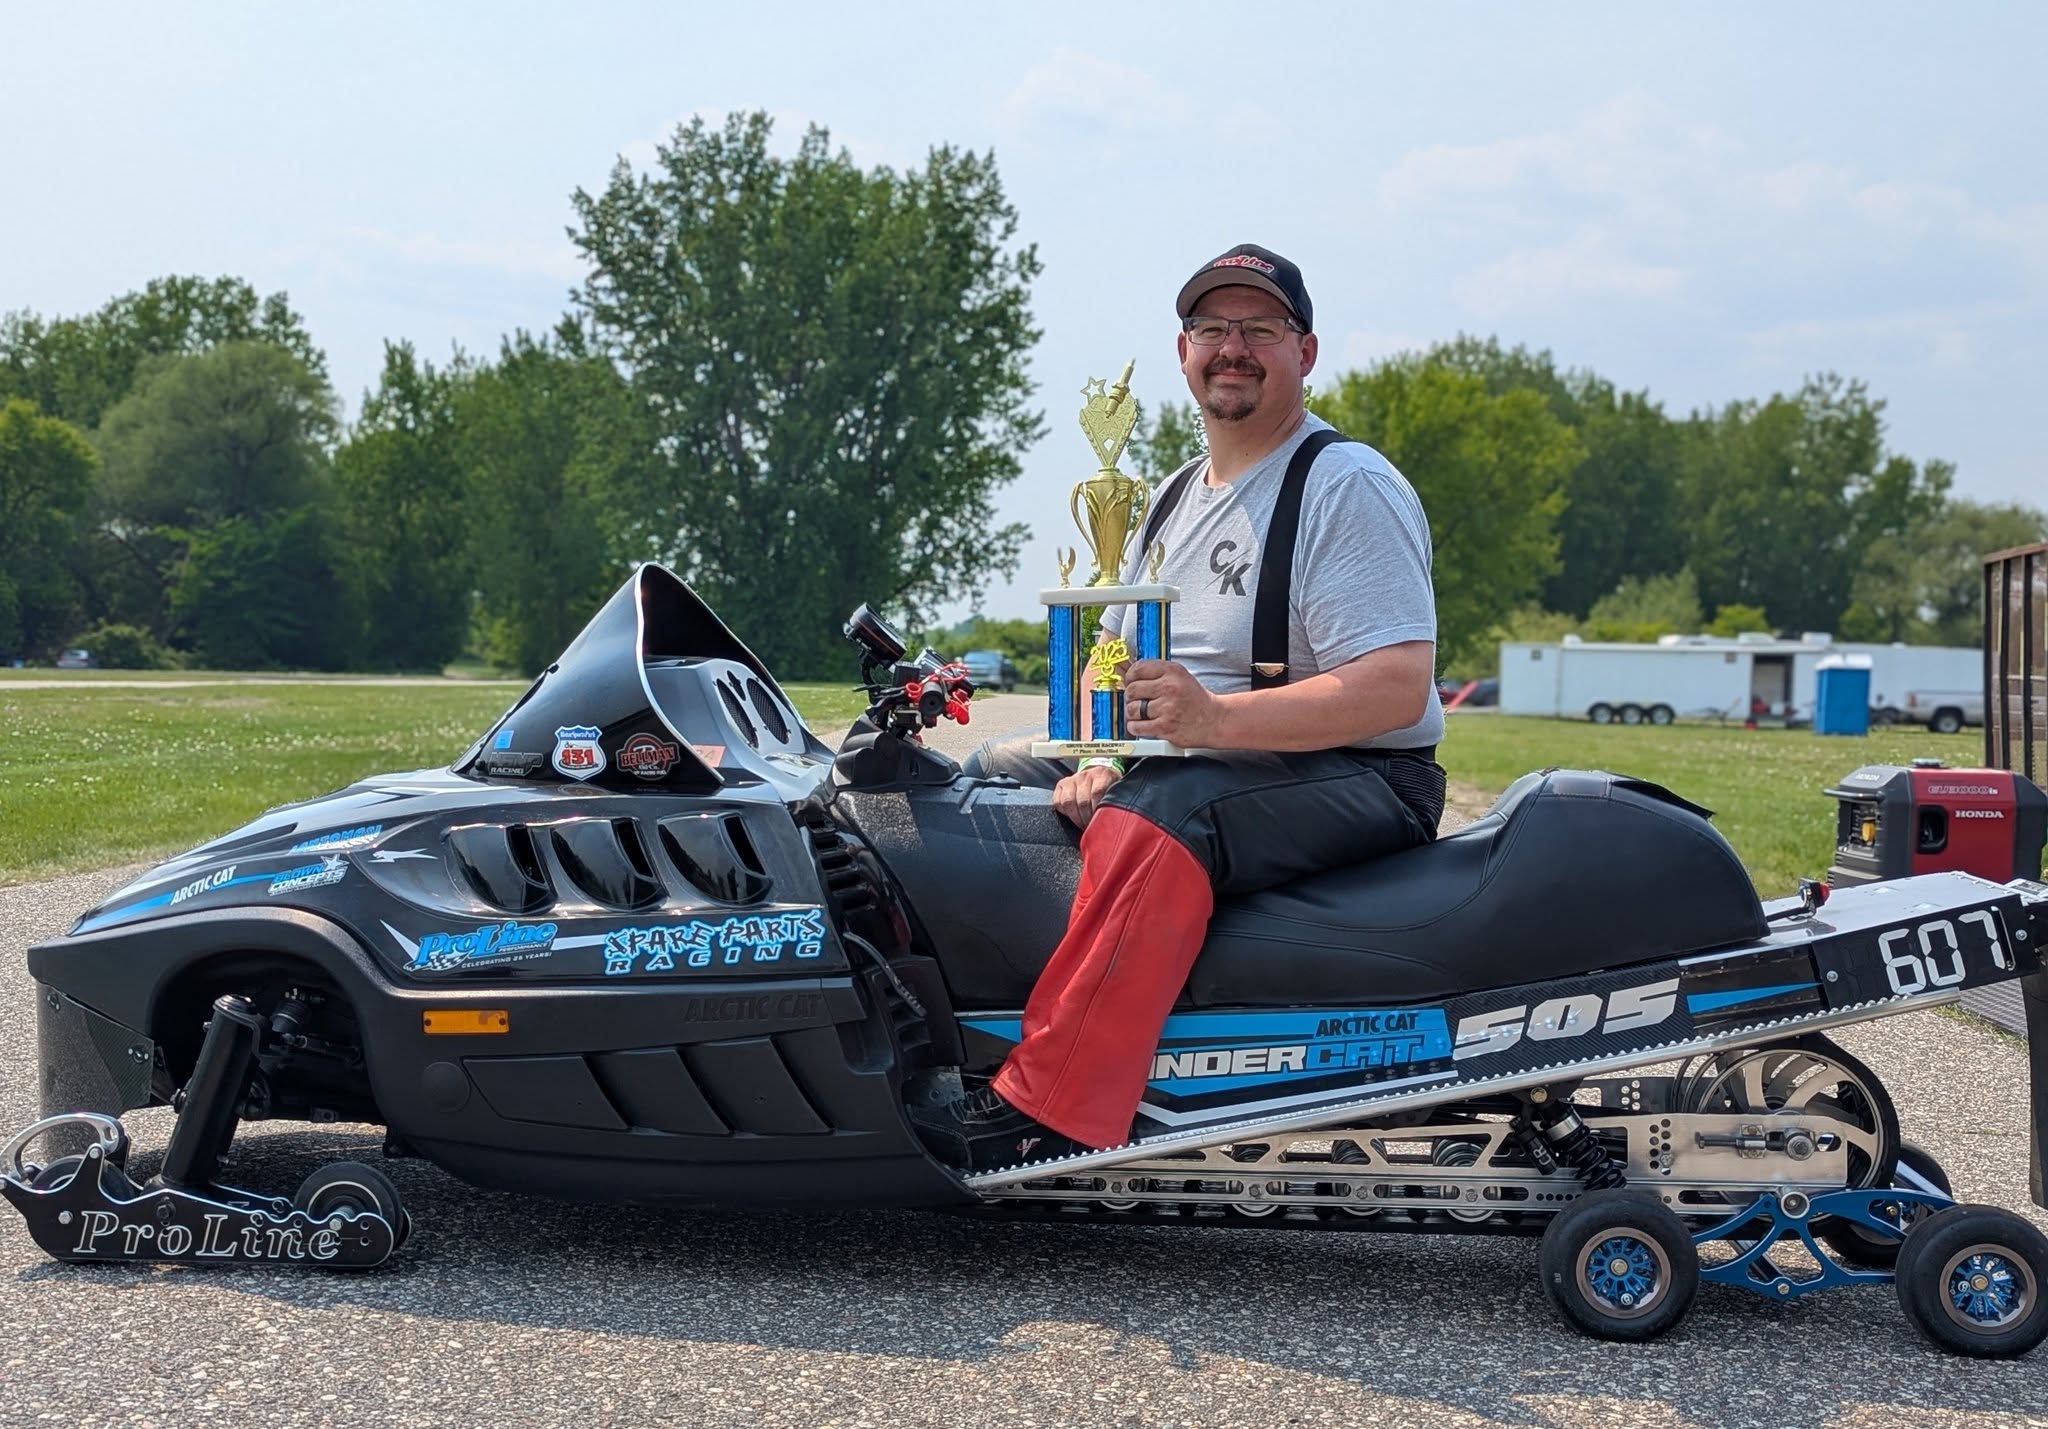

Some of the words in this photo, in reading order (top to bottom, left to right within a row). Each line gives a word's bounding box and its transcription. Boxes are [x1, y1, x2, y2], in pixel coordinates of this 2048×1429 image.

[1090, 638, 1128, 666] 2025
[562, 748, 594, 766] 131
[621, 747, 675, 767] BELLMAN
[1955, 810, 2004, 818] HONDA
[170, 874, 213, 906] ARCTIC
[212, 865, 237, 886] CAT
[270, 869, 346, 891] CONCEPTS
[415, 921, 557, 966] ProLine
[605, 921, 715, 957] SPARE
[719, 910, 824, 947] PARTS
[461, 957, 511, 968] CELEBRATING
[525, 952, 552, 960] YEARS!
[606, 943, 823, 975] RACING
[1878, 910, 2007, 995] 607
[684, 996, 770, 1023] ARCTIC
[777, 993, 823, 1019] CAT
[1452, 978, 1679, 1061] 505
[1316, 1014, 1383, 1038] ARCTIC
[1383, 1011, 1419, 1033] CAT
[1149, 1037, 1424, 1080] NDERCAT
[73, 1210, 341, 1261] ProLine
